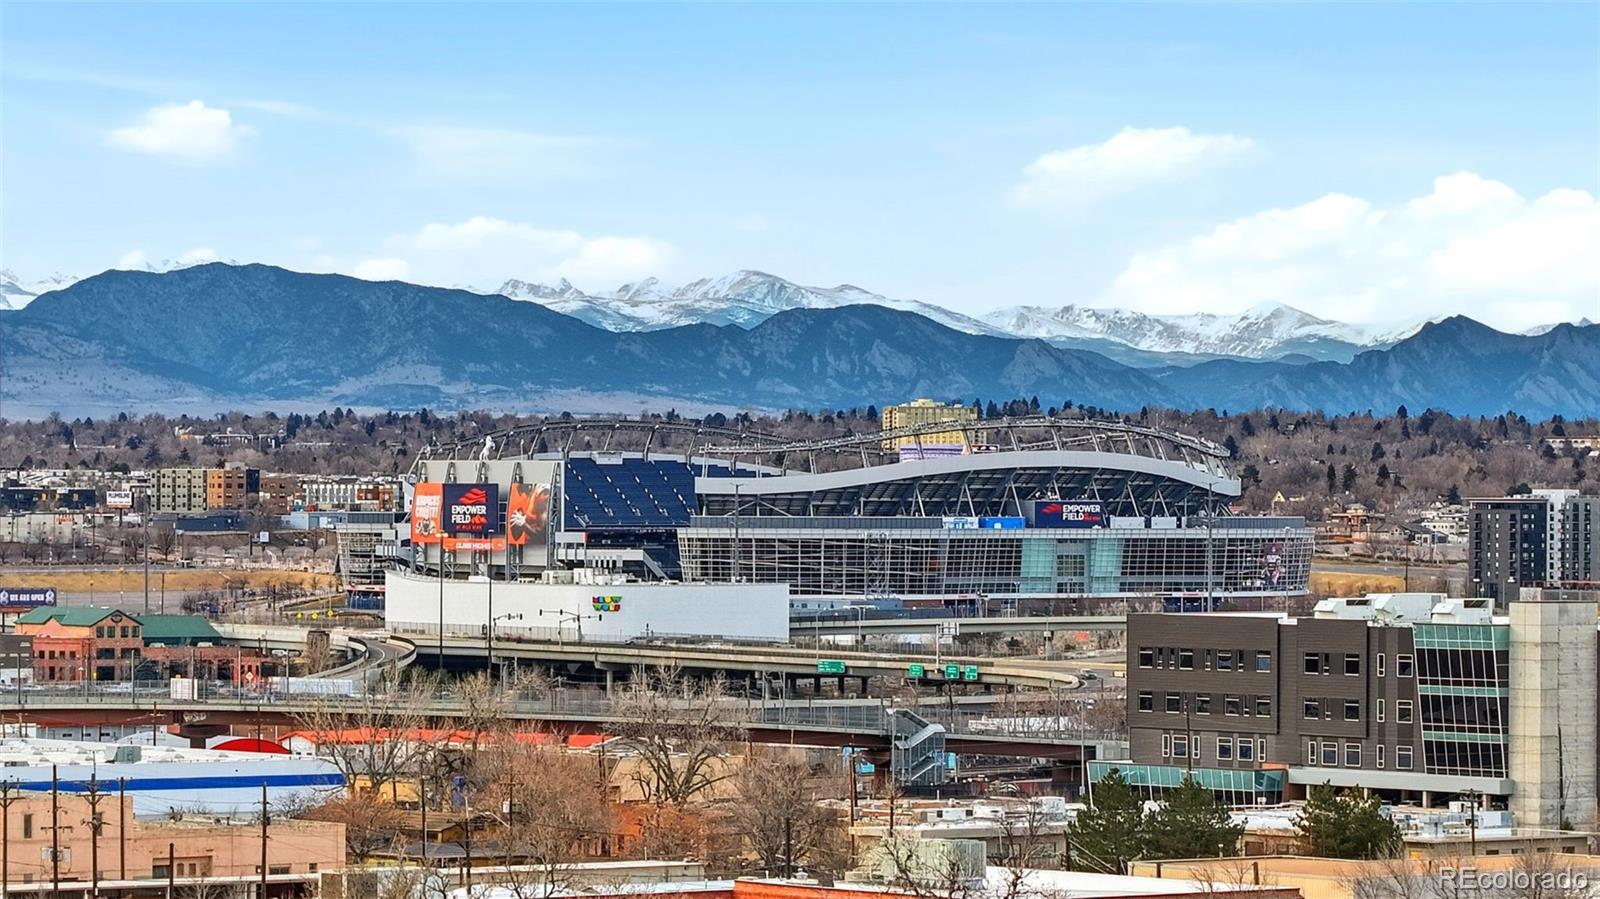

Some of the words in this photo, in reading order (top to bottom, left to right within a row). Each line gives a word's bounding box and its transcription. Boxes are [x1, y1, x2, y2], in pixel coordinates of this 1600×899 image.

[451, 505, 487, 515] EMPOWER
[1062, 504, 1101, 513] EMPOWER
[451, 515, 471, 524] FIELD
[1062, 513, 1084, 521] FIELD
[592, 596, 622, 604] MEOW
[592, 604, 621, 612] WOLF
